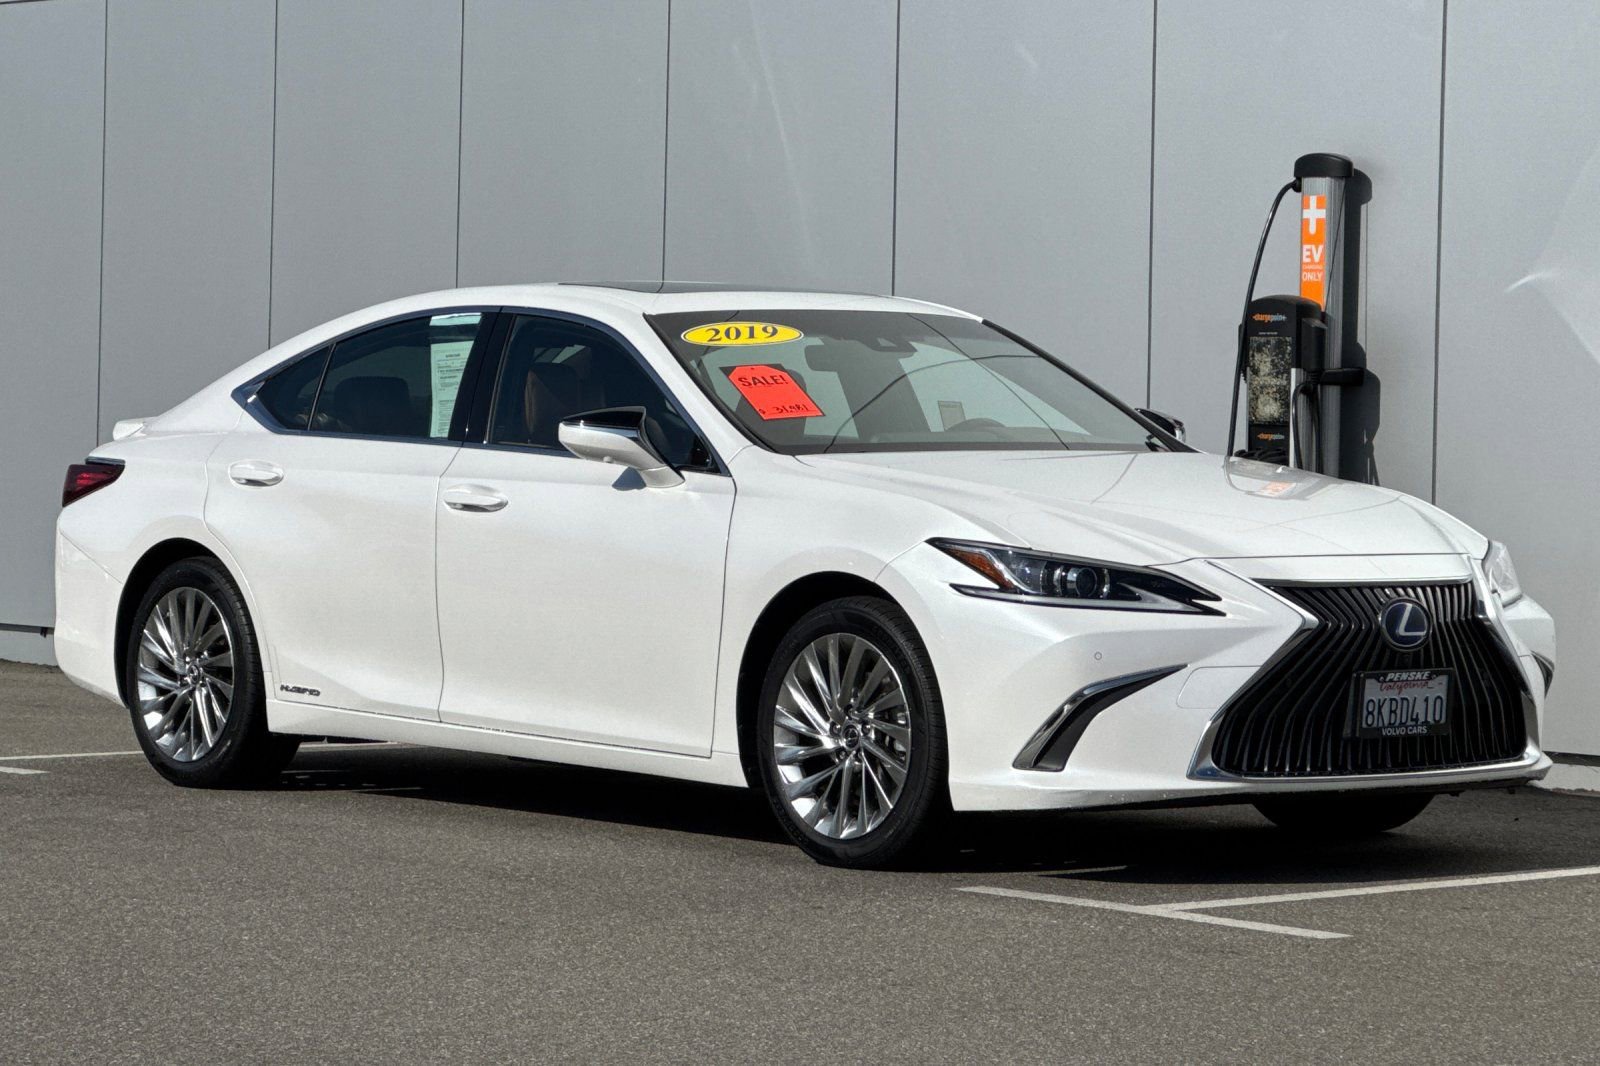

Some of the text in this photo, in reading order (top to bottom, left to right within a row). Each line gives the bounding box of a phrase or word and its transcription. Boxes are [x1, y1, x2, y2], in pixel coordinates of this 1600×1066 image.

[1303, 244, 1324, 263] EV
[1302, 271, 1323, 282] ONLY
[705, 325, 778, 342] 2019
[738, 374, 789, 387] SALE!
[1386, 671, 1431, 682] PENSKE
[1365, 695, 1444, 727] 8KBD410
[1381, 725, 1428, 736] VOLVO CARS
